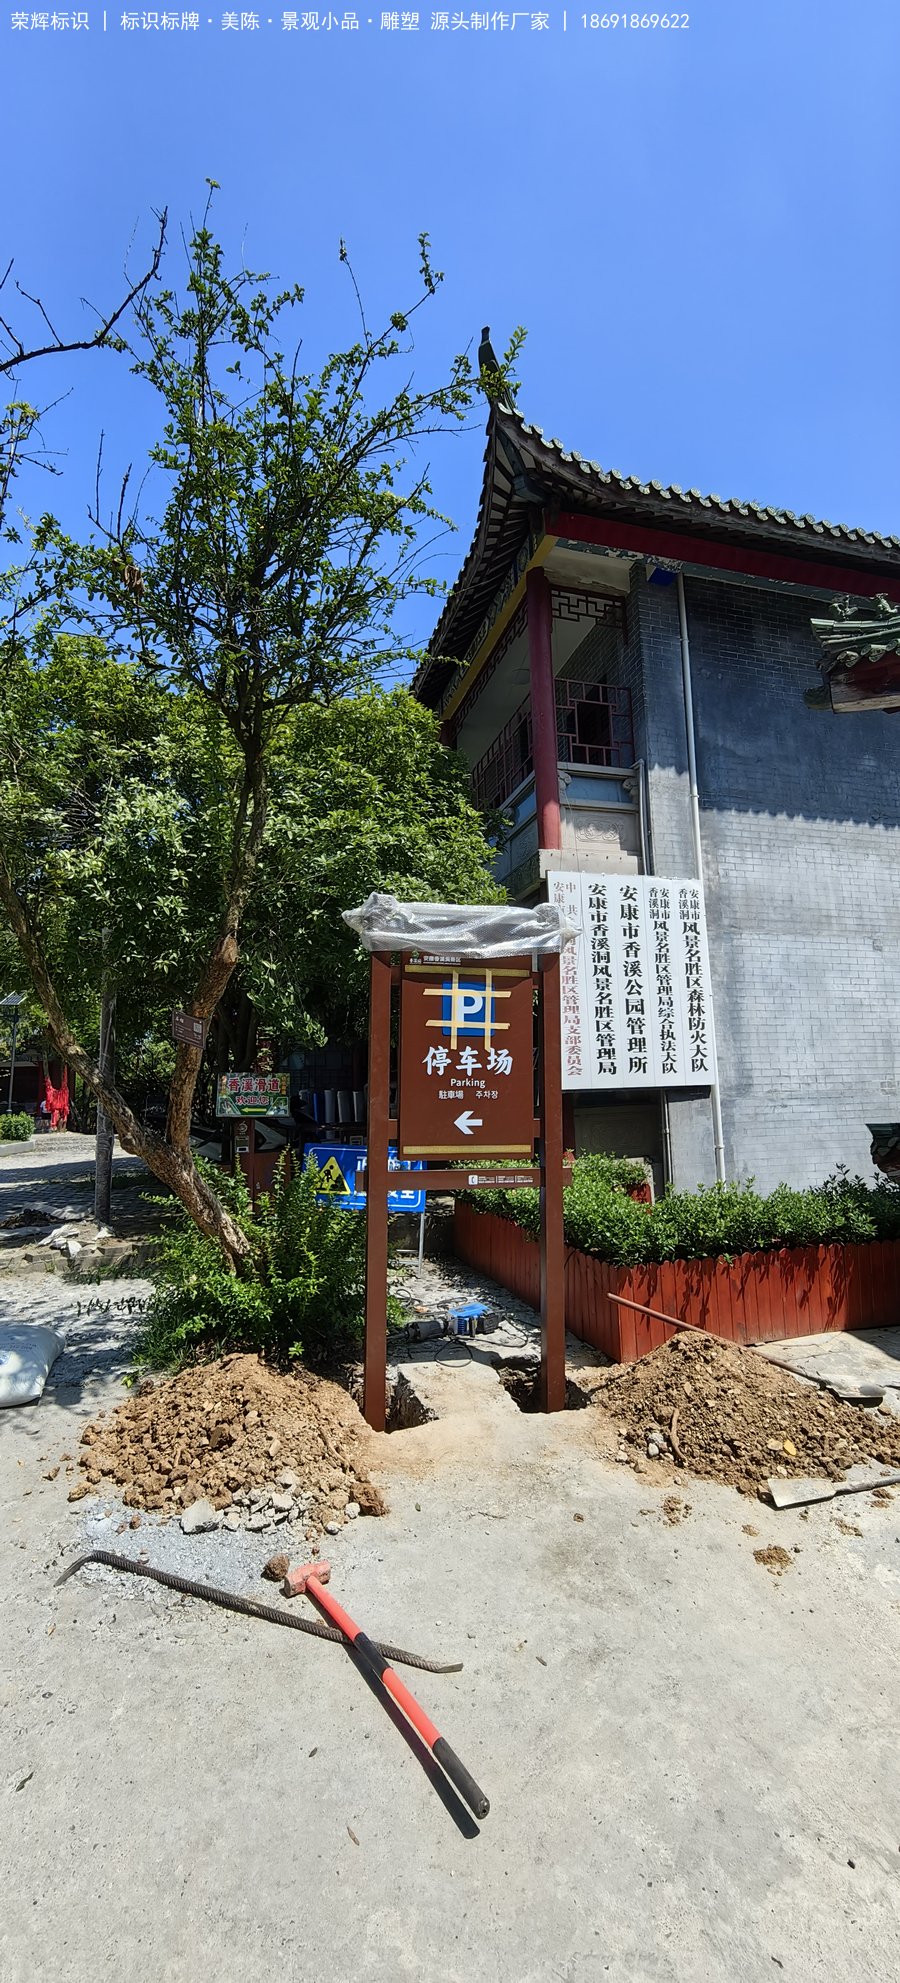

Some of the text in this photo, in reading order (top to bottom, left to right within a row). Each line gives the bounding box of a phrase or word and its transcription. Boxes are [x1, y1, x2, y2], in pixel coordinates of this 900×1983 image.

[588, 883, 617, 1075] 安康市香溪洞风景名胜区管理局
[619, 885, 648, 1074] 安康市香溪公园管理所
[456, 989, 484, 1028] P
[422, 1046, 513, 1077] 停车场
[227, 1077, 280, 1093] 香溪滑道
[450, 1078, 486, 1089] Parking
